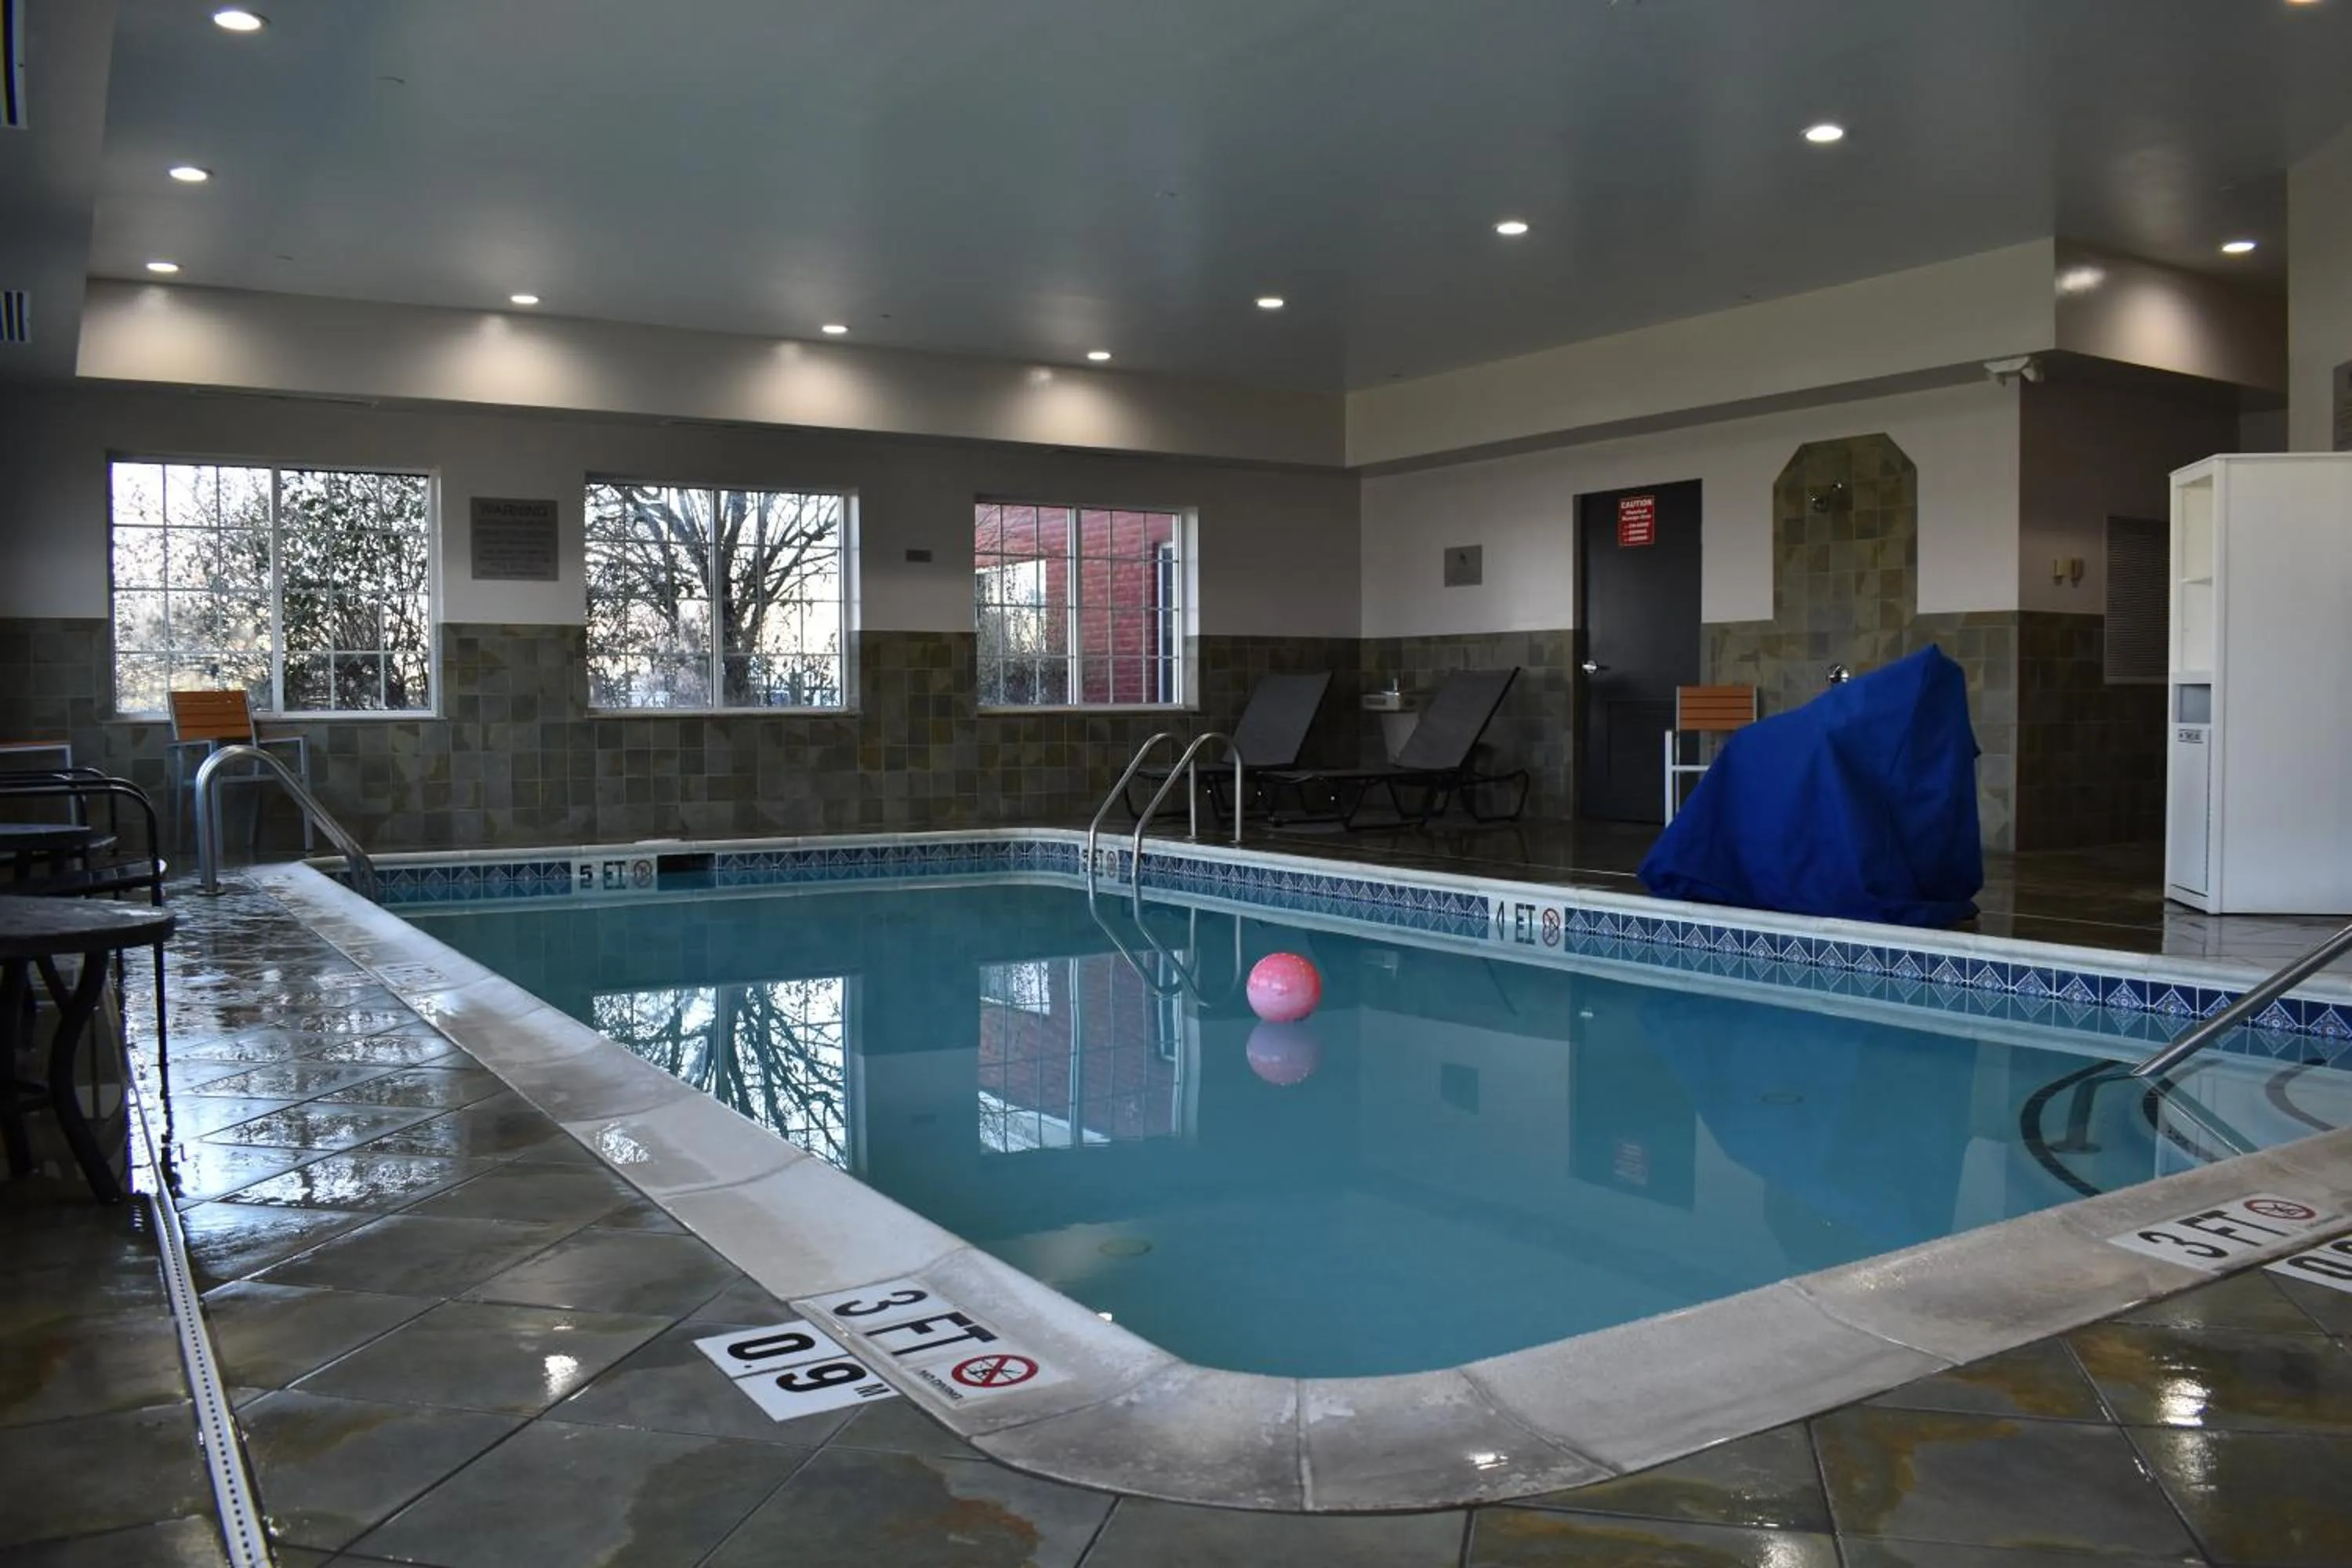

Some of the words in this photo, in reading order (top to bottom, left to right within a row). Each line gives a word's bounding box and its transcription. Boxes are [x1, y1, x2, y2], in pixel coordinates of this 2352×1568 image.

[1621, 499, 1652, 508] CAUTION
[2177, 1210, 2291, 1247] FT
[2138, 1231, 2229, 1258] 3
[833, 1290, 928, 1316] 3
[866, 1312, 997, 1356] FT
